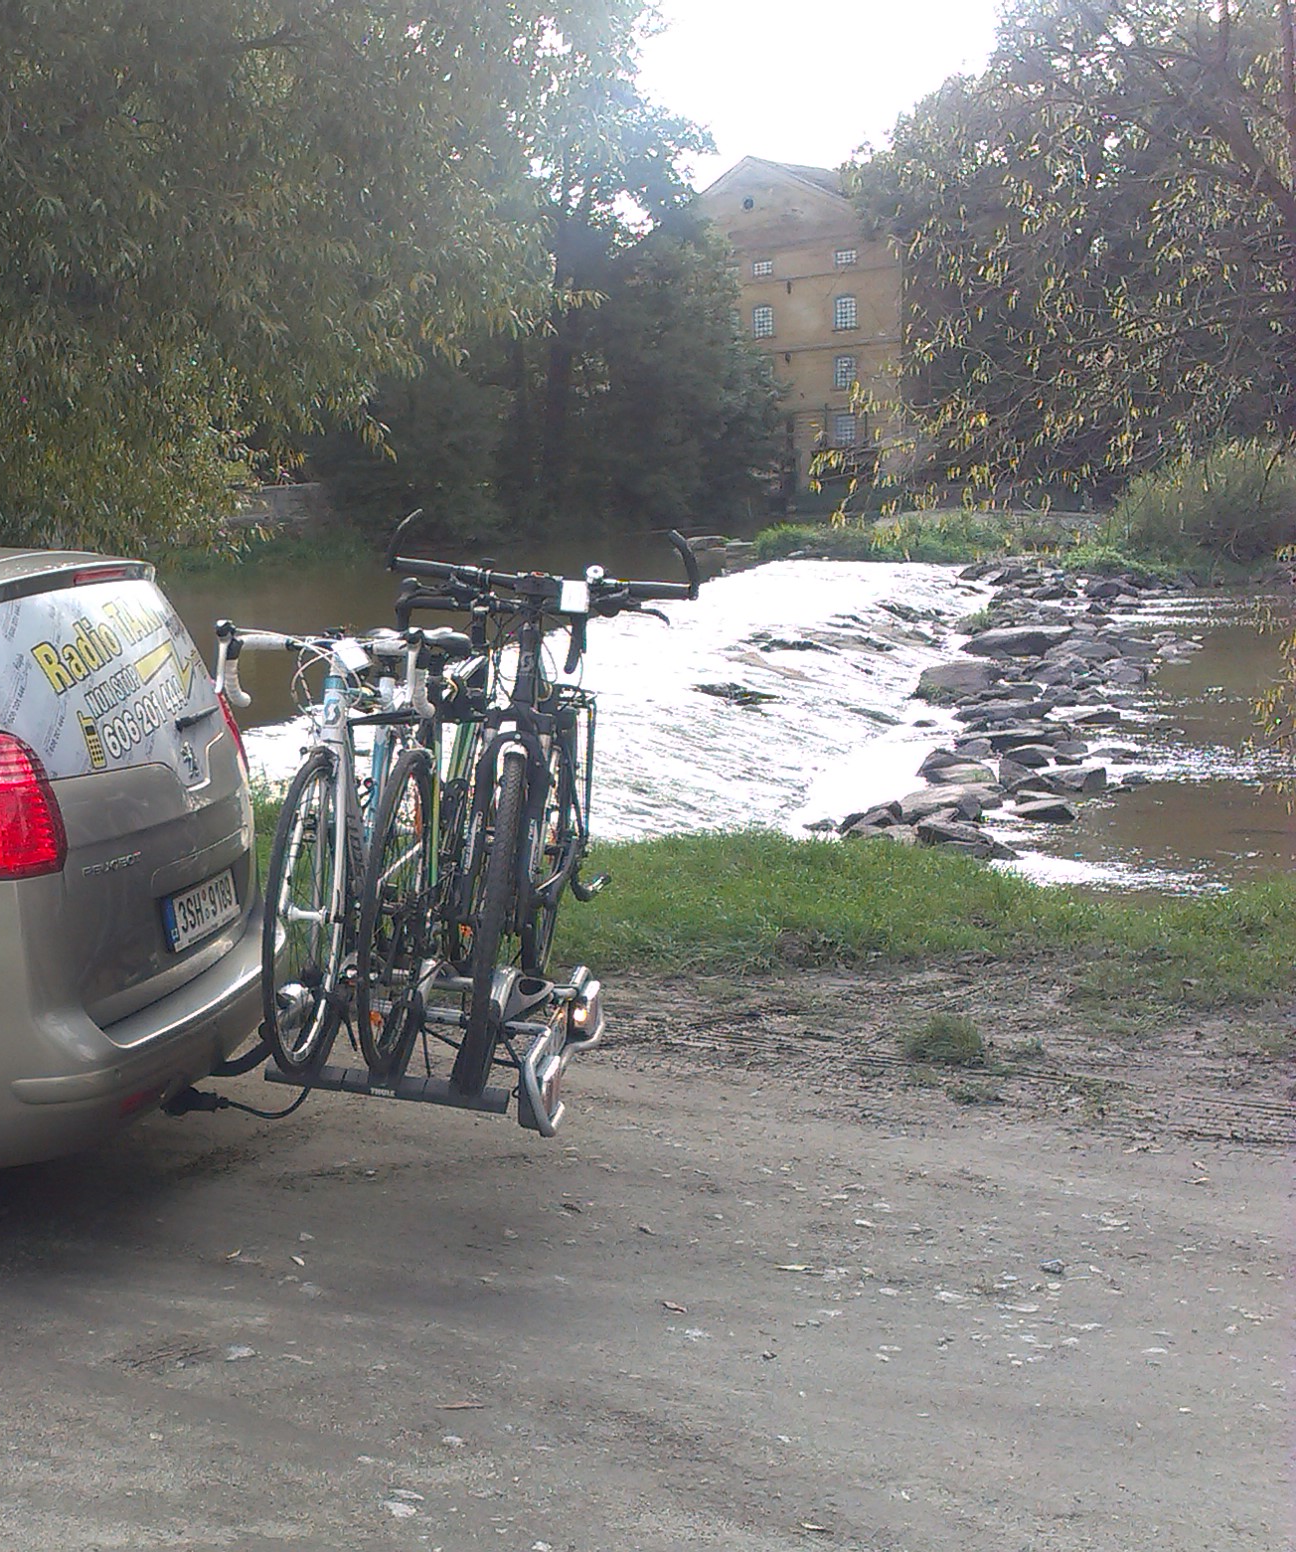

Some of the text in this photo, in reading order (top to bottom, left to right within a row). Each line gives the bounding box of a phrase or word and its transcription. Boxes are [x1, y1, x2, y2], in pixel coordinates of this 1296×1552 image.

[31, 616, 122, 695] Radio
[84, 663, 140, 719] NON STOP
[103, 675, 188, 758] 606 201 444
[82, 851, 141, 878] PEUGEOT
[178, 893, 204, 933] 3SH
